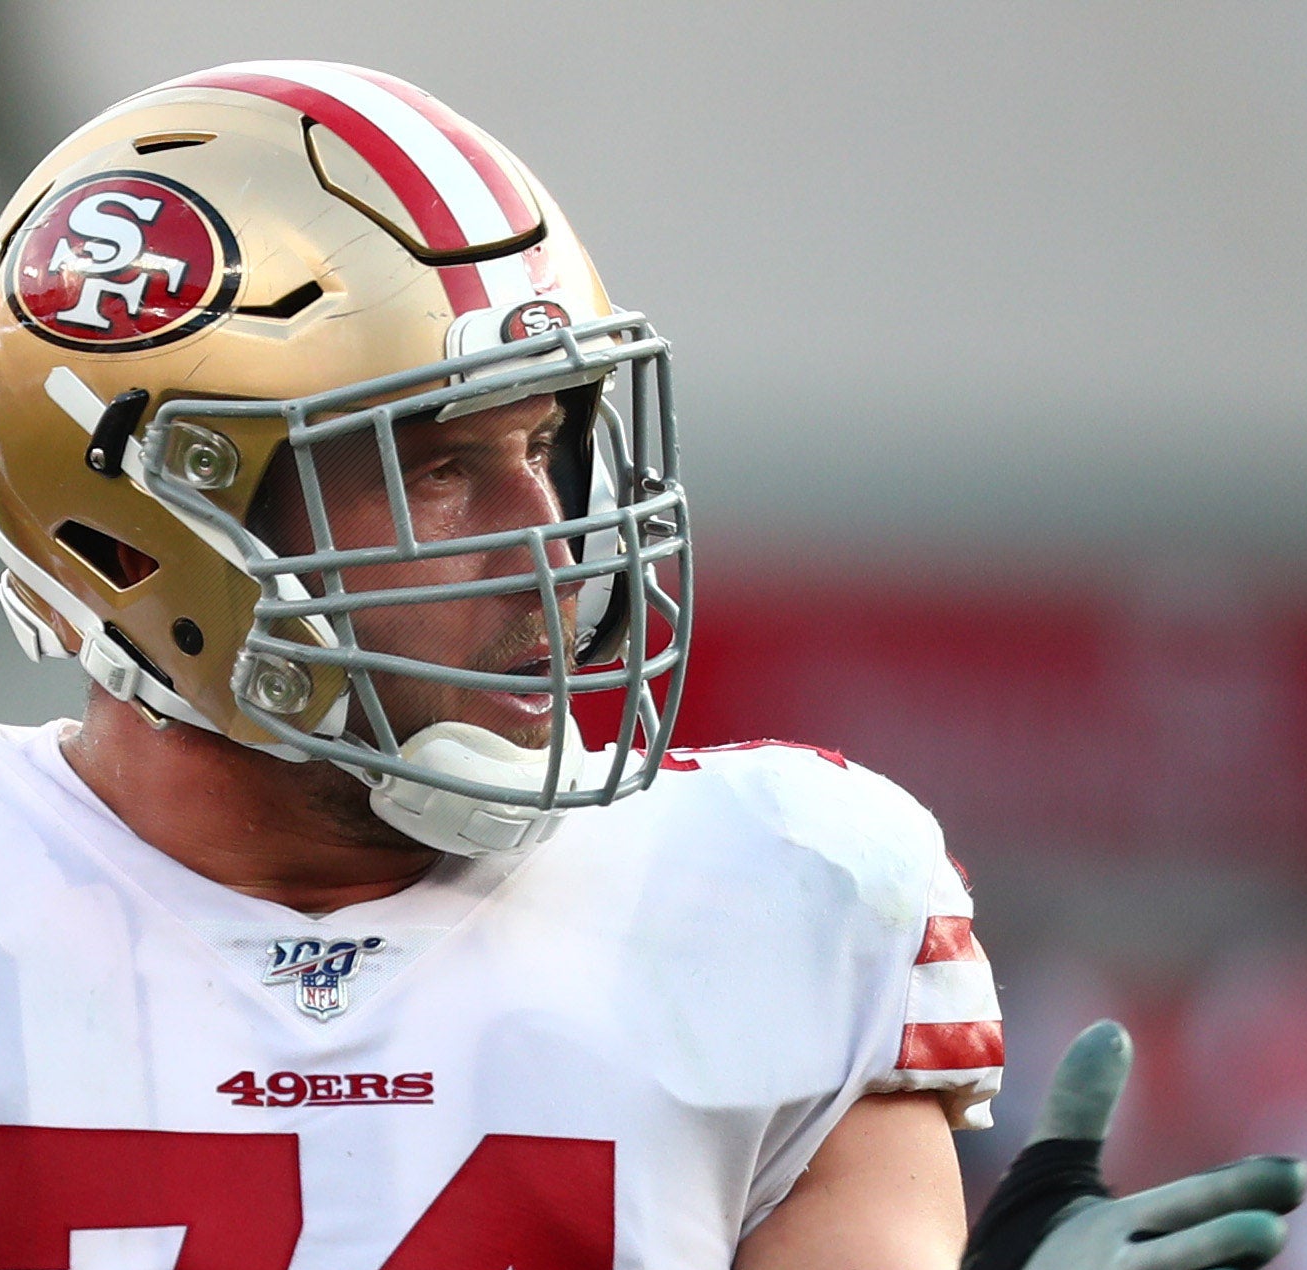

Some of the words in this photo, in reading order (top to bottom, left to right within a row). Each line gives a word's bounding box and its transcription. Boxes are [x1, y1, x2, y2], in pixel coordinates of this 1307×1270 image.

[48, 191, 188, 330] SF
[306, 987, 337, 1008] NFL
[216, 1071, 434, 1107] 49ERS
